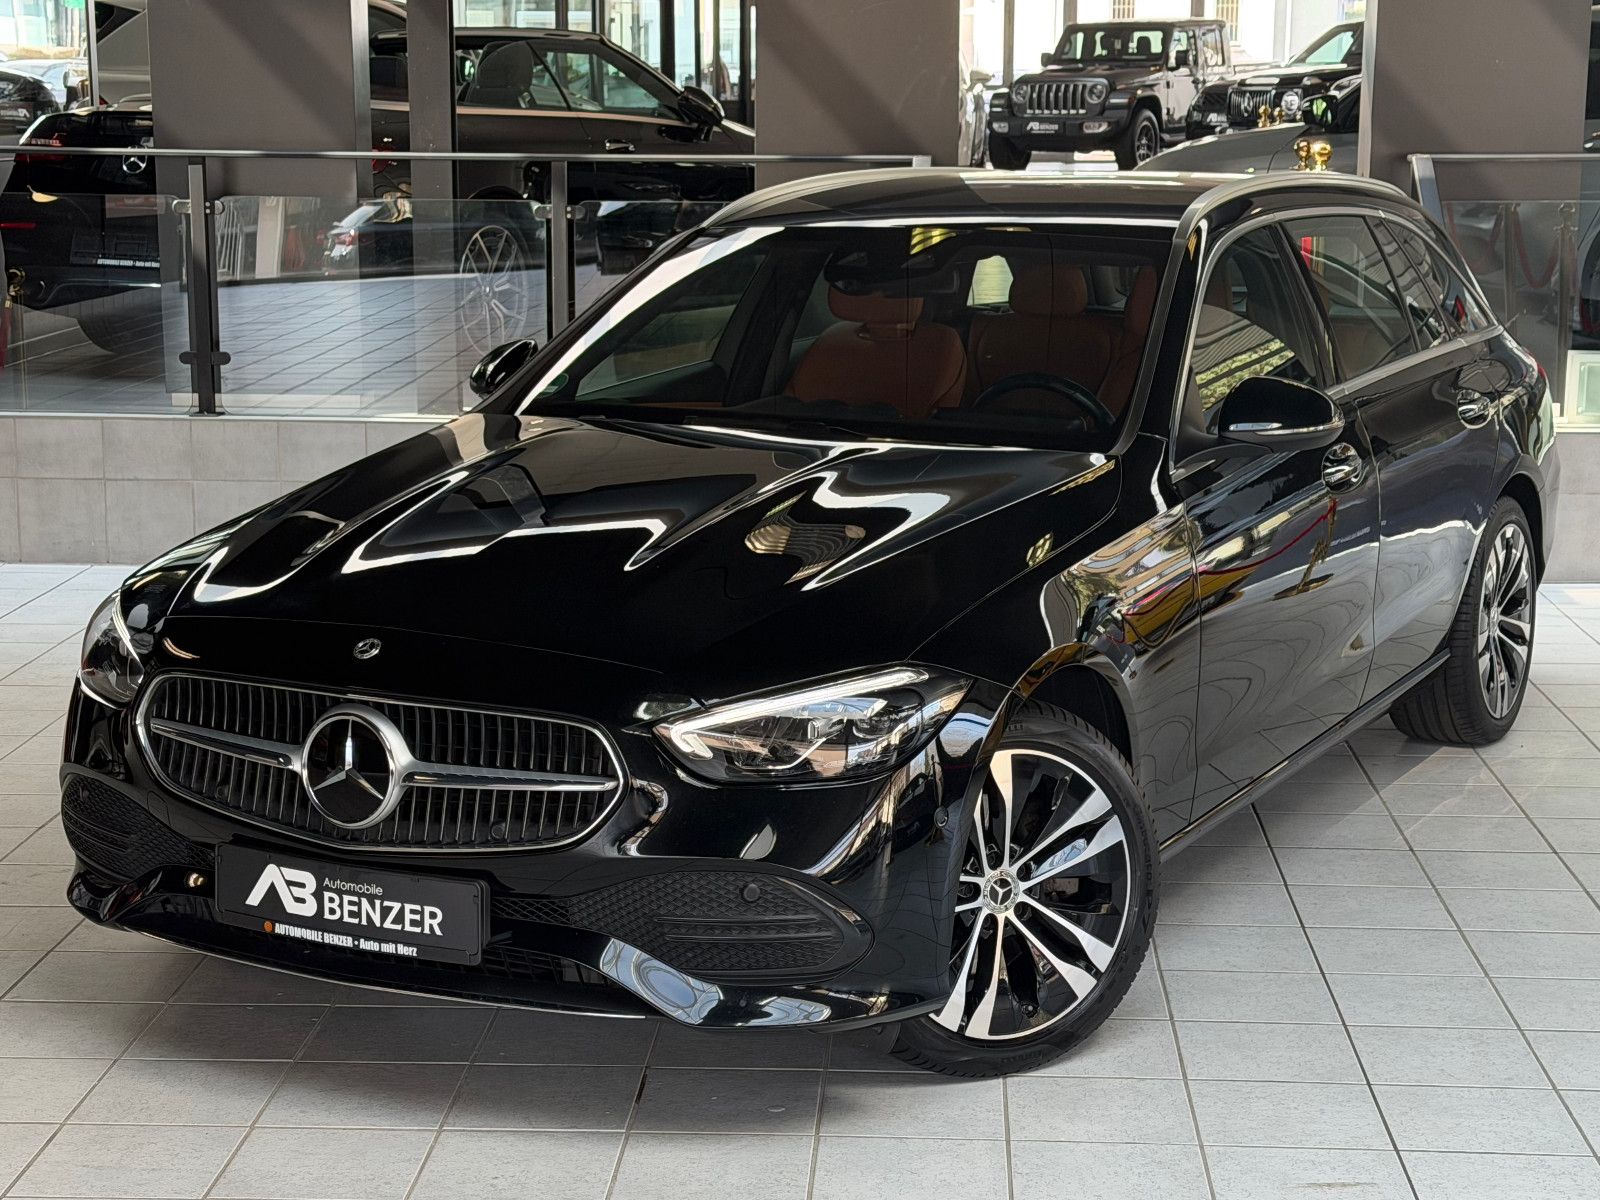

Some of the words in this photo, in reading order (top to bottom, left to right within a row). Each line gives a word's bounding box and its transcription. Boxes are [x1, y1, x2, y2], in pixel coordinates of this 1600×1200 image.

[245, 863, 318, 917] AB
[323, 877, 384, 896] Automobile
[323, 891, 444, 936] BENZER
[274, 923, 323, 943] AUTOMOBILE
[323, 932, 354, 948] BENZER
[359, 938, 380, 952] Auto
[380, 942, 397, 954] mit
[397, 943, 418, 957] Herz
